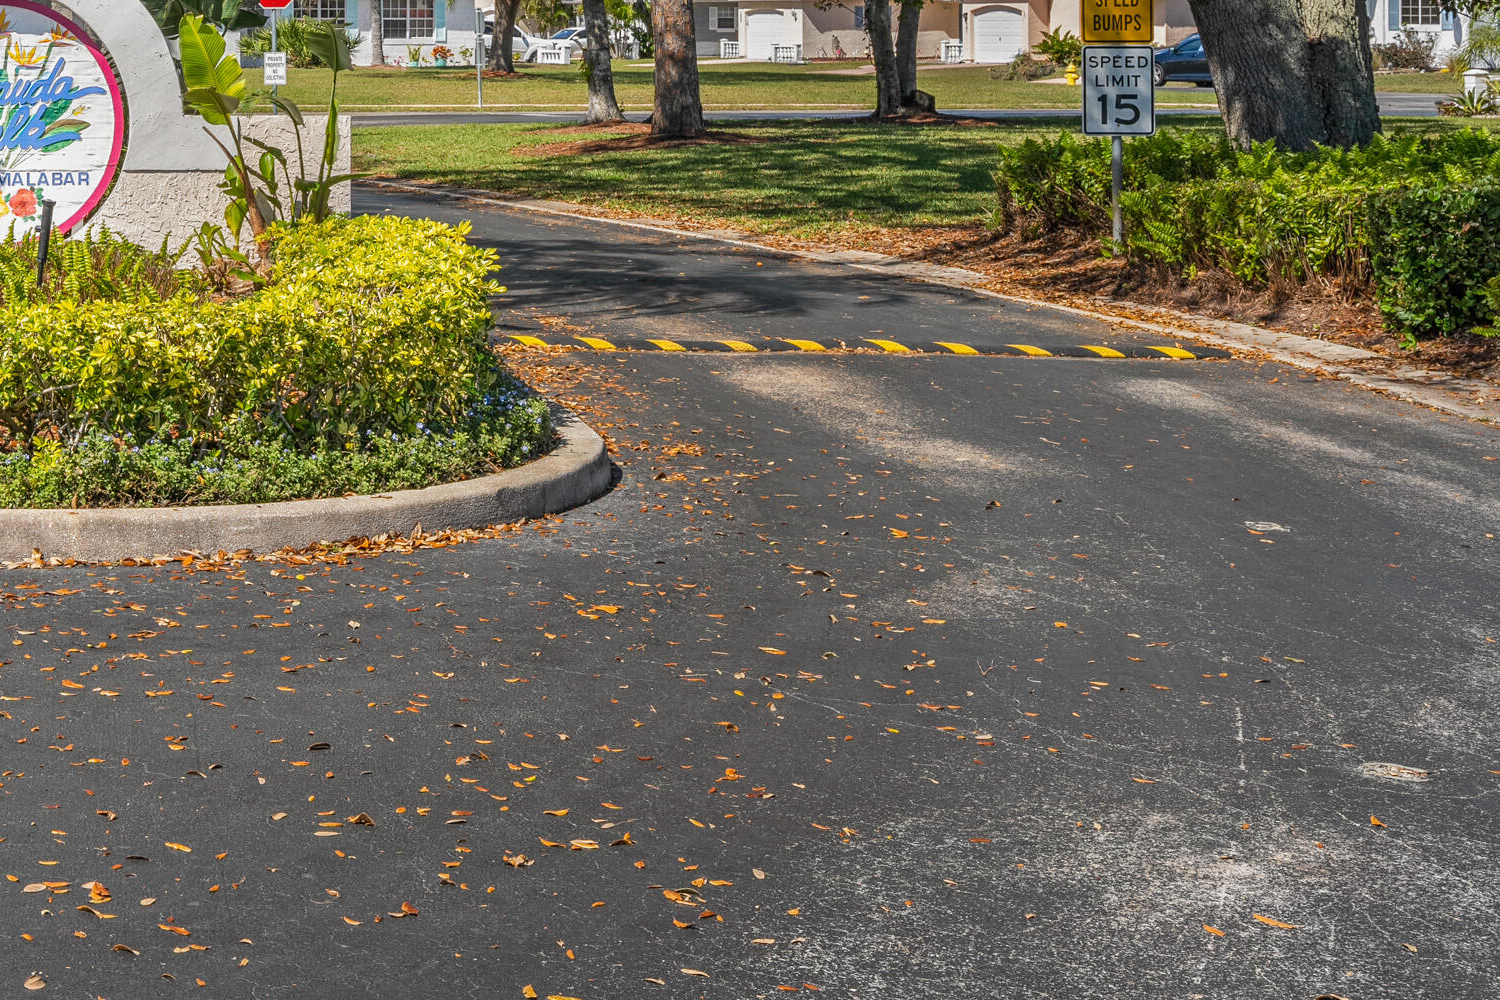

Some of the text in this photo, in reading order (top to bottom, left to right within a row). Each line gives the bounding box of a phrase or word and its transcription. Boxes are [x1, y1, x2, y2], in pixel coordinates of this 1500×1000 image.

[1092, 14, 1142, 32] BUMPS
[1088, 56, 1149, 69] SPEED
[1095, 75, 1141, 88] LIMIT
[1097, 94, 1141, 125] 15
